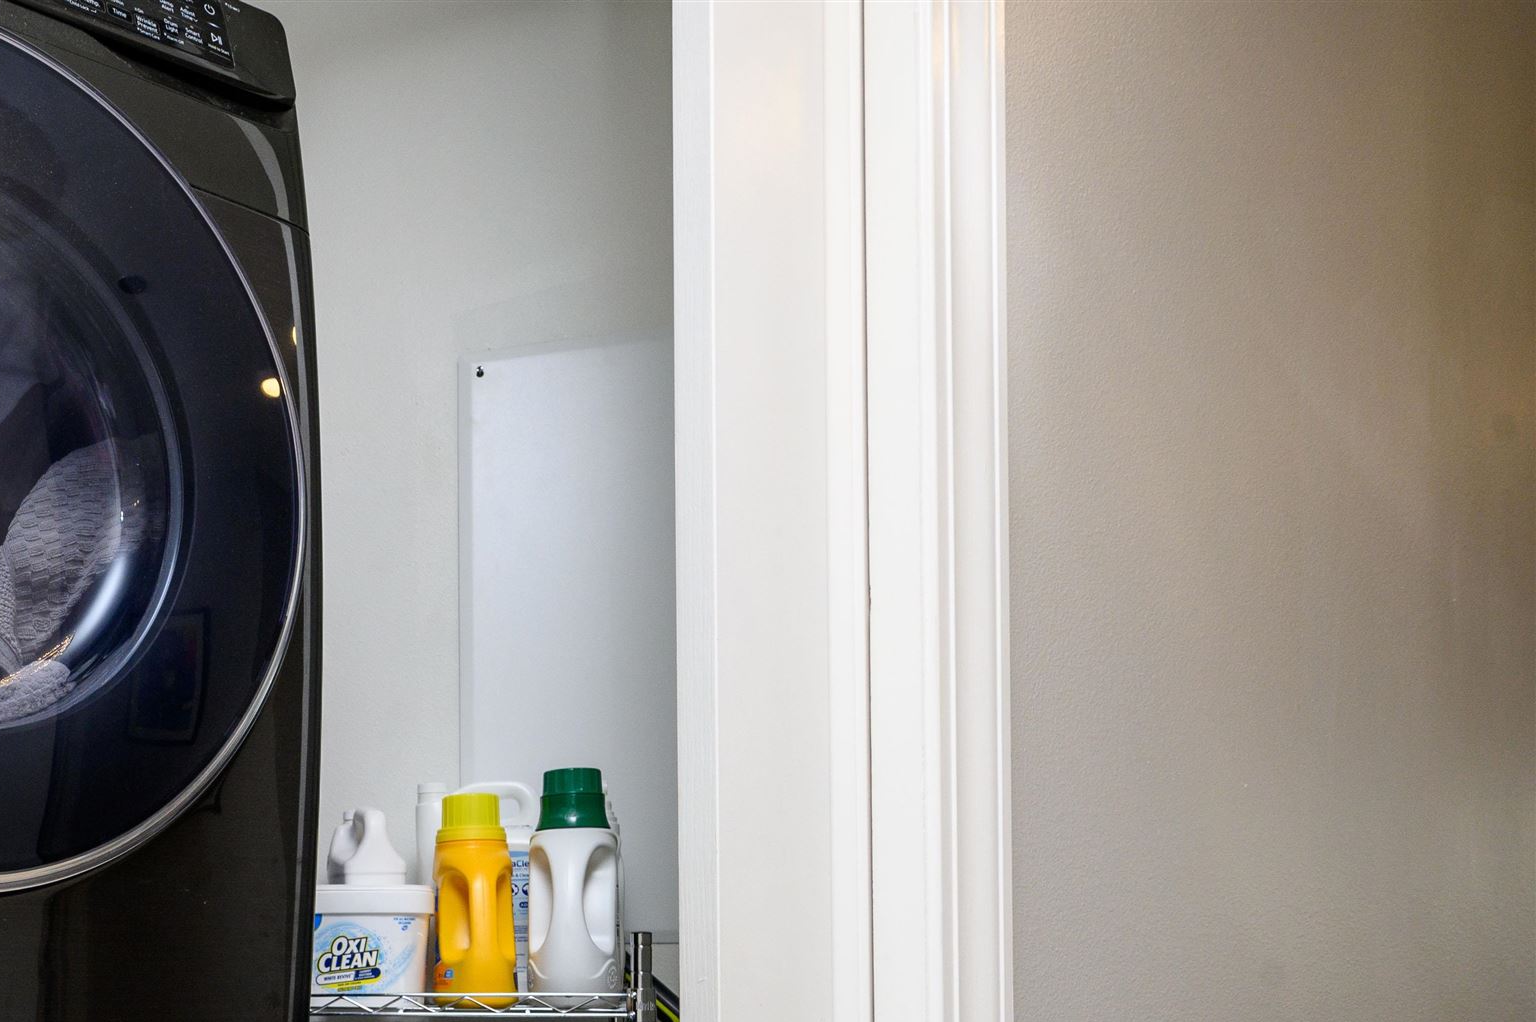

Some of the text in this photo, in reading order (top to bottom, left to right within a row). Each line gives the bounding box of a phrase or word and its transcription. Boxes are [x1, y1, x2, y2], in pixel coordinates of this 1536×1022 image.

[112, 7, 127, 18] Time
[136, 15, 157, 28] Wrinkle
[164, 18, 178, 28] Drum
[185, 27, 201, 38] Smart
[331, 936, 368, 956] OXI
[318, 950, 379, 973] CLEAN
